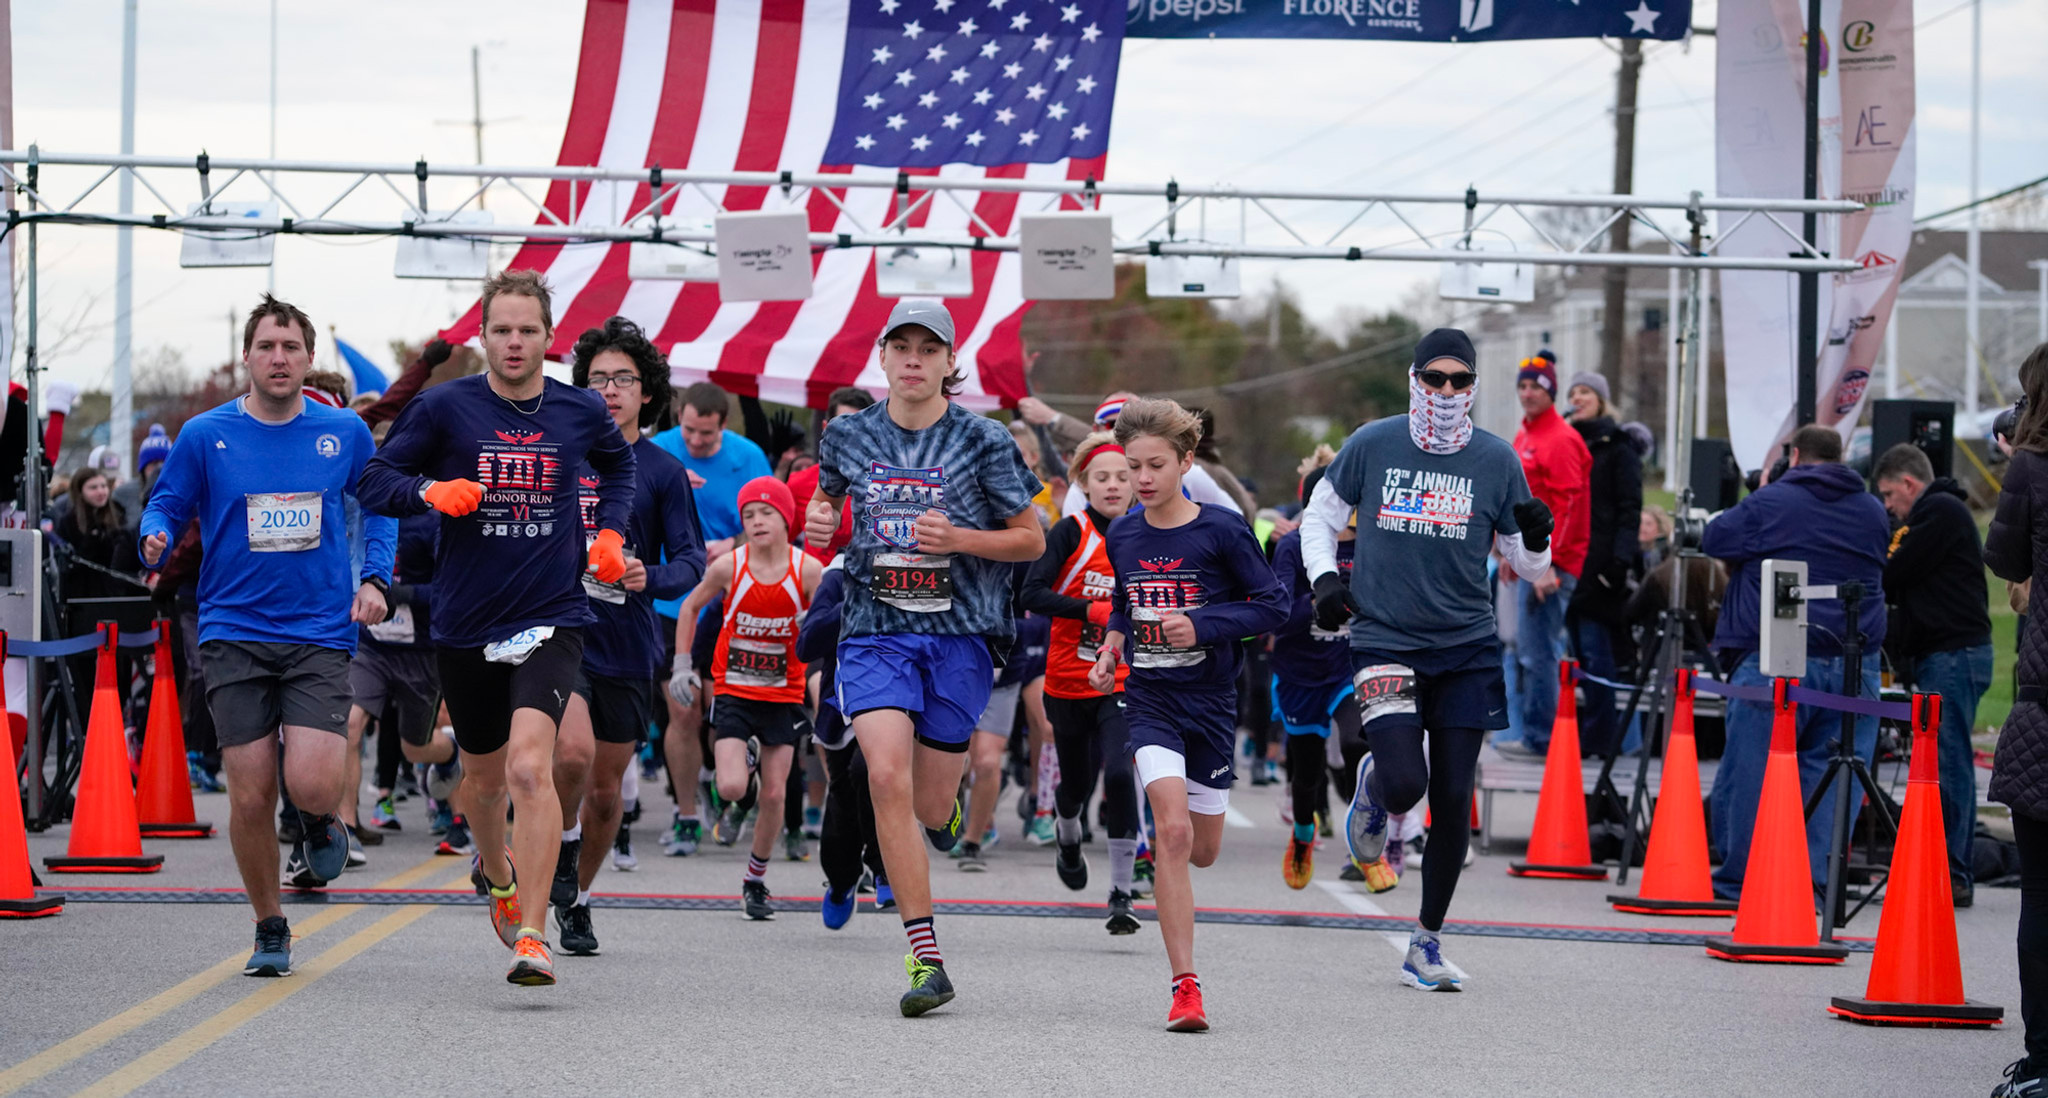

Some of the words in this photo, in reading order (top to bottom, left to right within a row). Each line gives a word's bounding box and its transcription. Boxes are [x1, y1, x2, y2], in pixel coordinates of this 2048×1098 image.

[1149, 0, 1239, 22] pepsi
[1283, 0, 1421, 26] FLORENCE
[1367, 19, 1421, 28] KENTUCKY
[1385, 467, 1411, 488] 13TH
[1411, 470, 1474, 498] ANNUAL
[484, 493, 528, 503] HONOR
[530, 494, 553, 504] RUN
[865, 483, 947, 509] STATE
[1382, 486, 1422, 508] VET
[1422, 490, 1473, 516] JAM
[260, 509, 311, 528] 2020
[511, 503, 530, 521] VI
[1376, 515, 1407, 532] JUNE
[1409, 519, 1436, 538] 8TH,
[1439, 523, 1468, 540] 2019
[884, 569, 938, 590] 3194
[736, 611, 793, 628] DERBY
[736, 626, 768, 636] CITY
[737, 651, 779, 670] 3123
[1361, 676, 1403, 702] 3377
